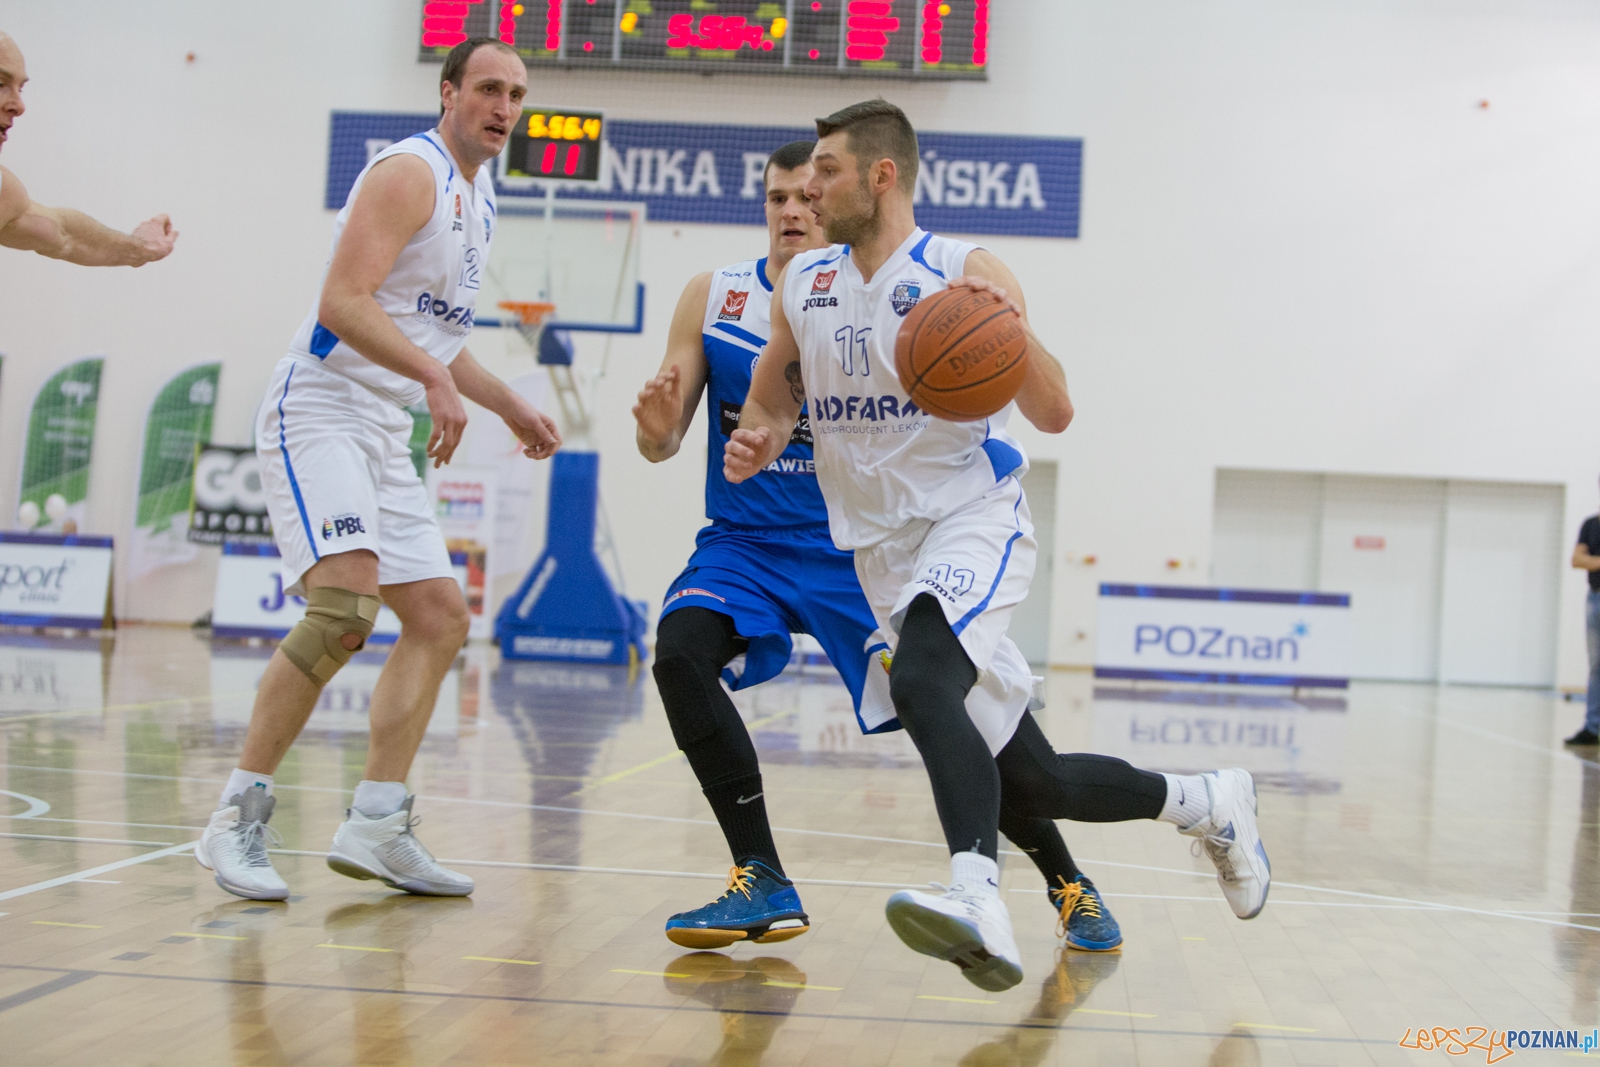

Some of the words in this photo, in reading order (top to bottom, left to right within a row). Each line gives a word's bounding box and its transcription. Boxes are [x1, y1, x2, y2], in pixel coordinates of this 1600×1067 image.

[540, 142, 581, 176] 11
[802, 296, 838, 312] joma
[835, 325, 872, 377] 11
[891, 420, 929, 434] LEKÓW
